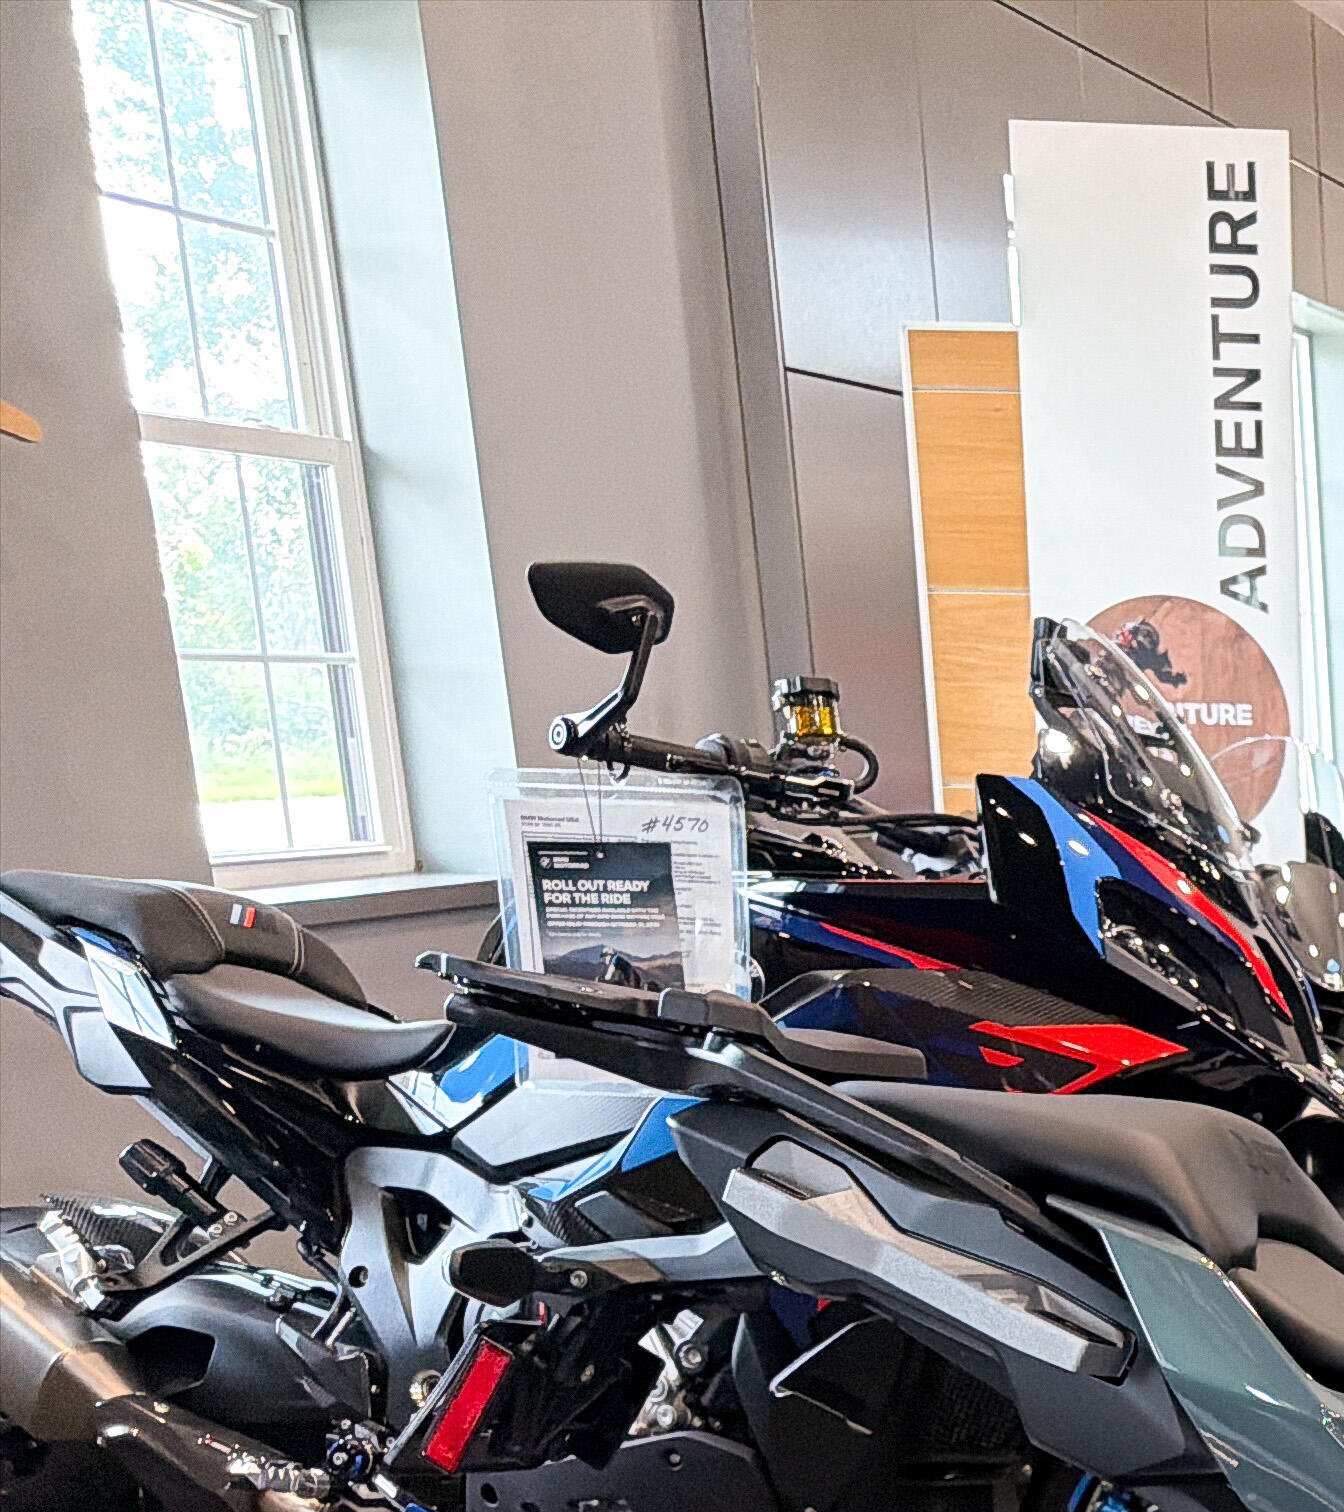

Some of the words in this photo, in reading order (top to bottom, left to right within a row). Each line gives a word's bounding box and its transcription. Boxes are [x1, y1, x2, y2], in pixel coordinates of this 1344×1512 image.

[1205, 160, 1270, 613] ADVENTURE
[541, 879, 576, 891] ROLL
[577, 879, 605, 892] OUT
[607, 880, 650, 892] READY
[543, 892, 571, 904] FOR
[574, 893, 599, 904] THE
[601, 893, 632, 904] RIDE
